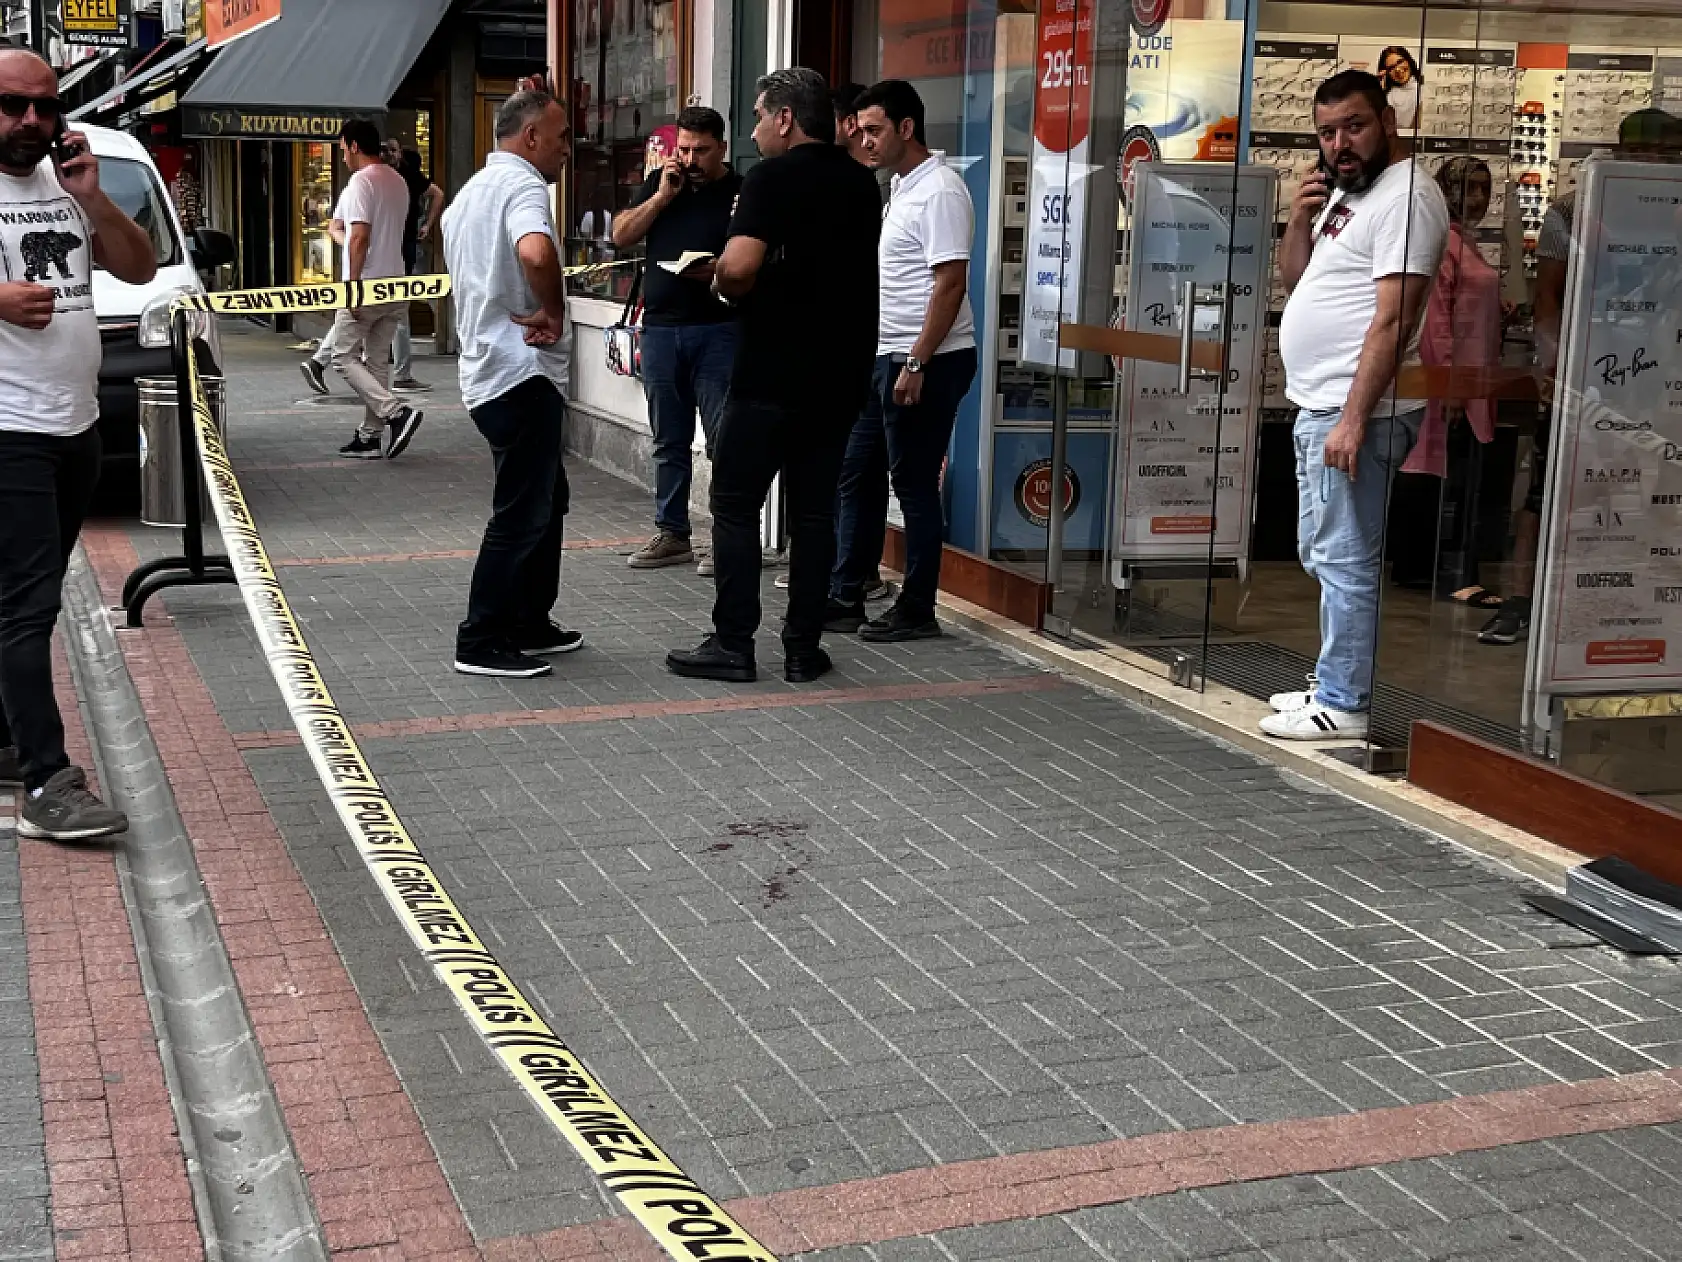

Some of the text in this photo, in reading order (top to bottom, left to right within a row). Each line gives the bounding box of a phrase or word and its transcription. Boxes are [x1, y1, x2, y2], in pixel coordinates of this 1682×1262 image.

[65, 0, 114, 17] EYFEL
[1129, 55, 1160, 68] ATI
[1076, 66, 1089, 85] TL
[1220, 206, 1258, 218] GESS
[1212, 284, 1252, 297] HGO
[1593, 347, 1659, 387] Ray-Ban
[644, 1199, 767, 1262] POL
